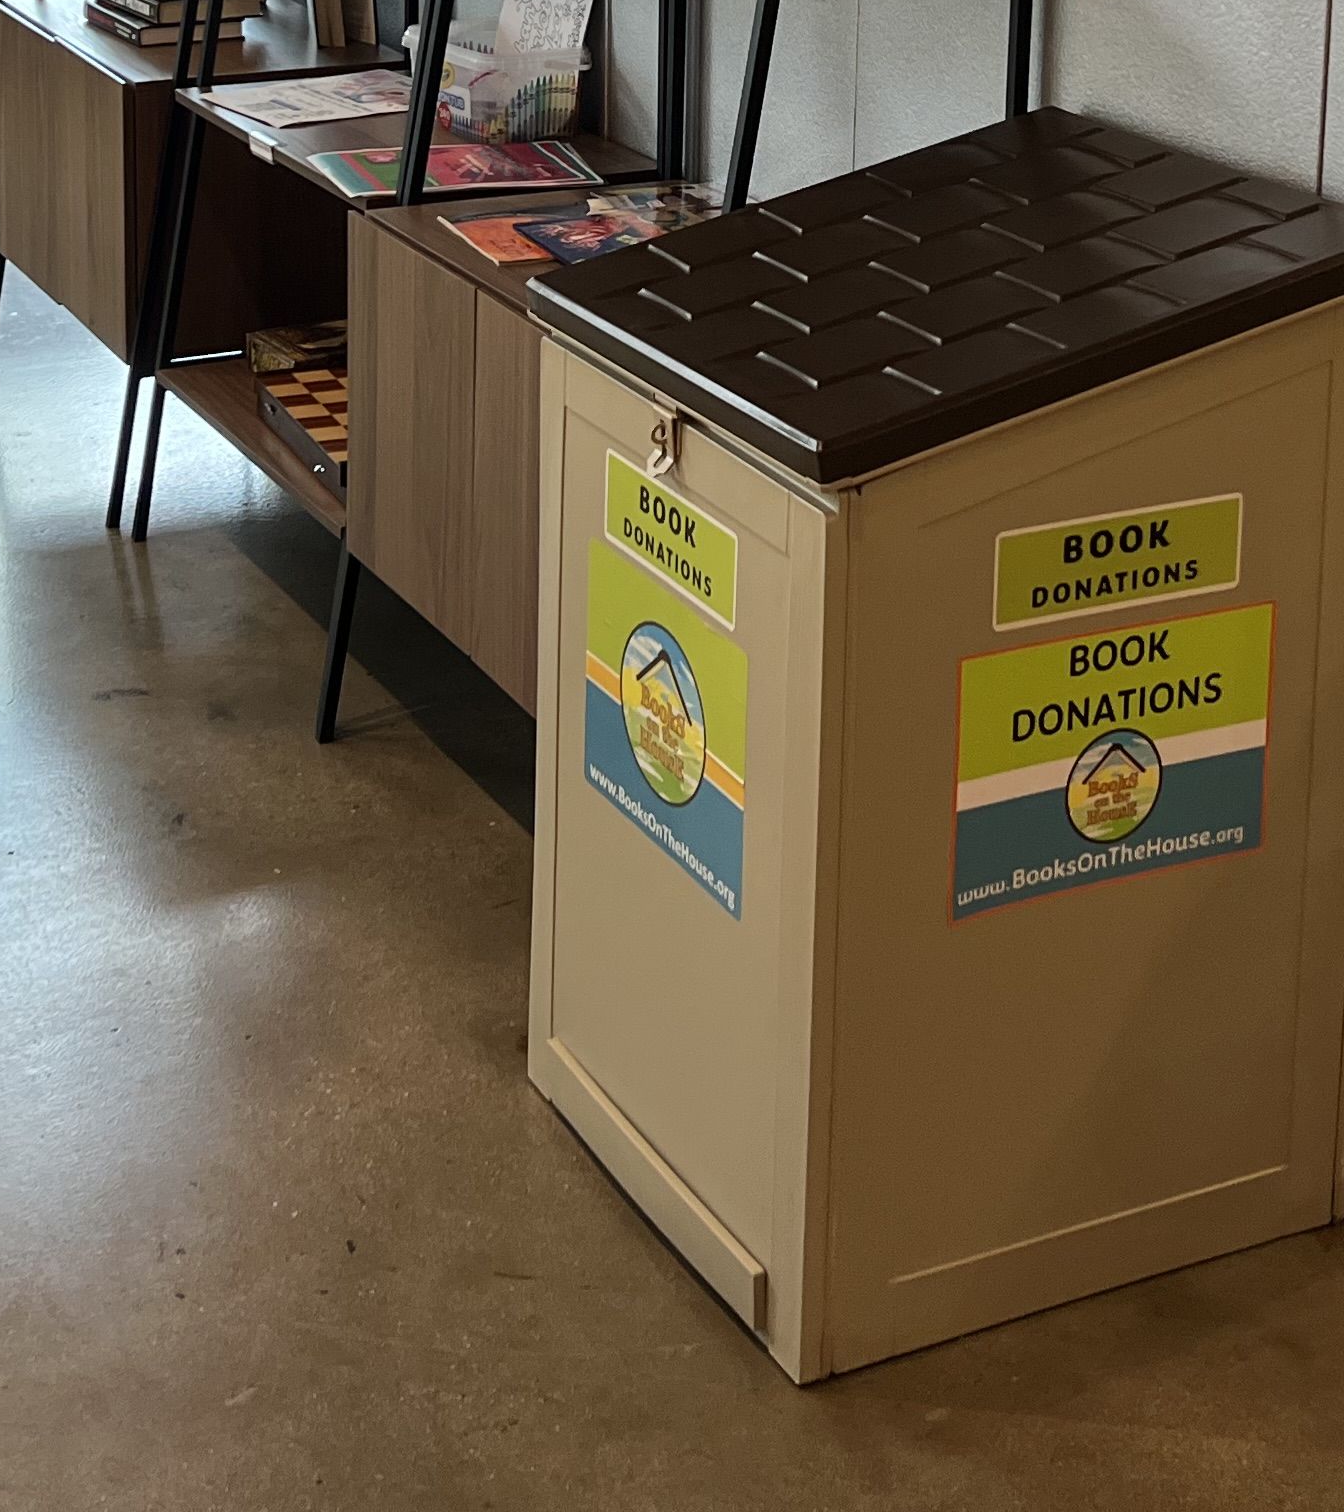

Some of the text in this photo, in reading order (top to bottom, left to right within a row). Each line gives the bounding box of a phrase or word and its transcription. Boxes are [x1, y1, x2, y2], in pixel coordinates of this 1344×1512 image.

[639, 484, 697, 549] BOOK
[1062, 519, 1172, 564] BOOK
[623, 517, 713, 598] DONATIONS
[1031, 559, 1200, 609] DONATIONS
[1068, 629, 1172, 677] BOOK
[1011, 672, 1223, 743] DONATIONS
[589, 761, 736, 911] www.BooksOnTheHouse.org
[956, 825, 1244, 908] www.BooksOnTheHouse.org
